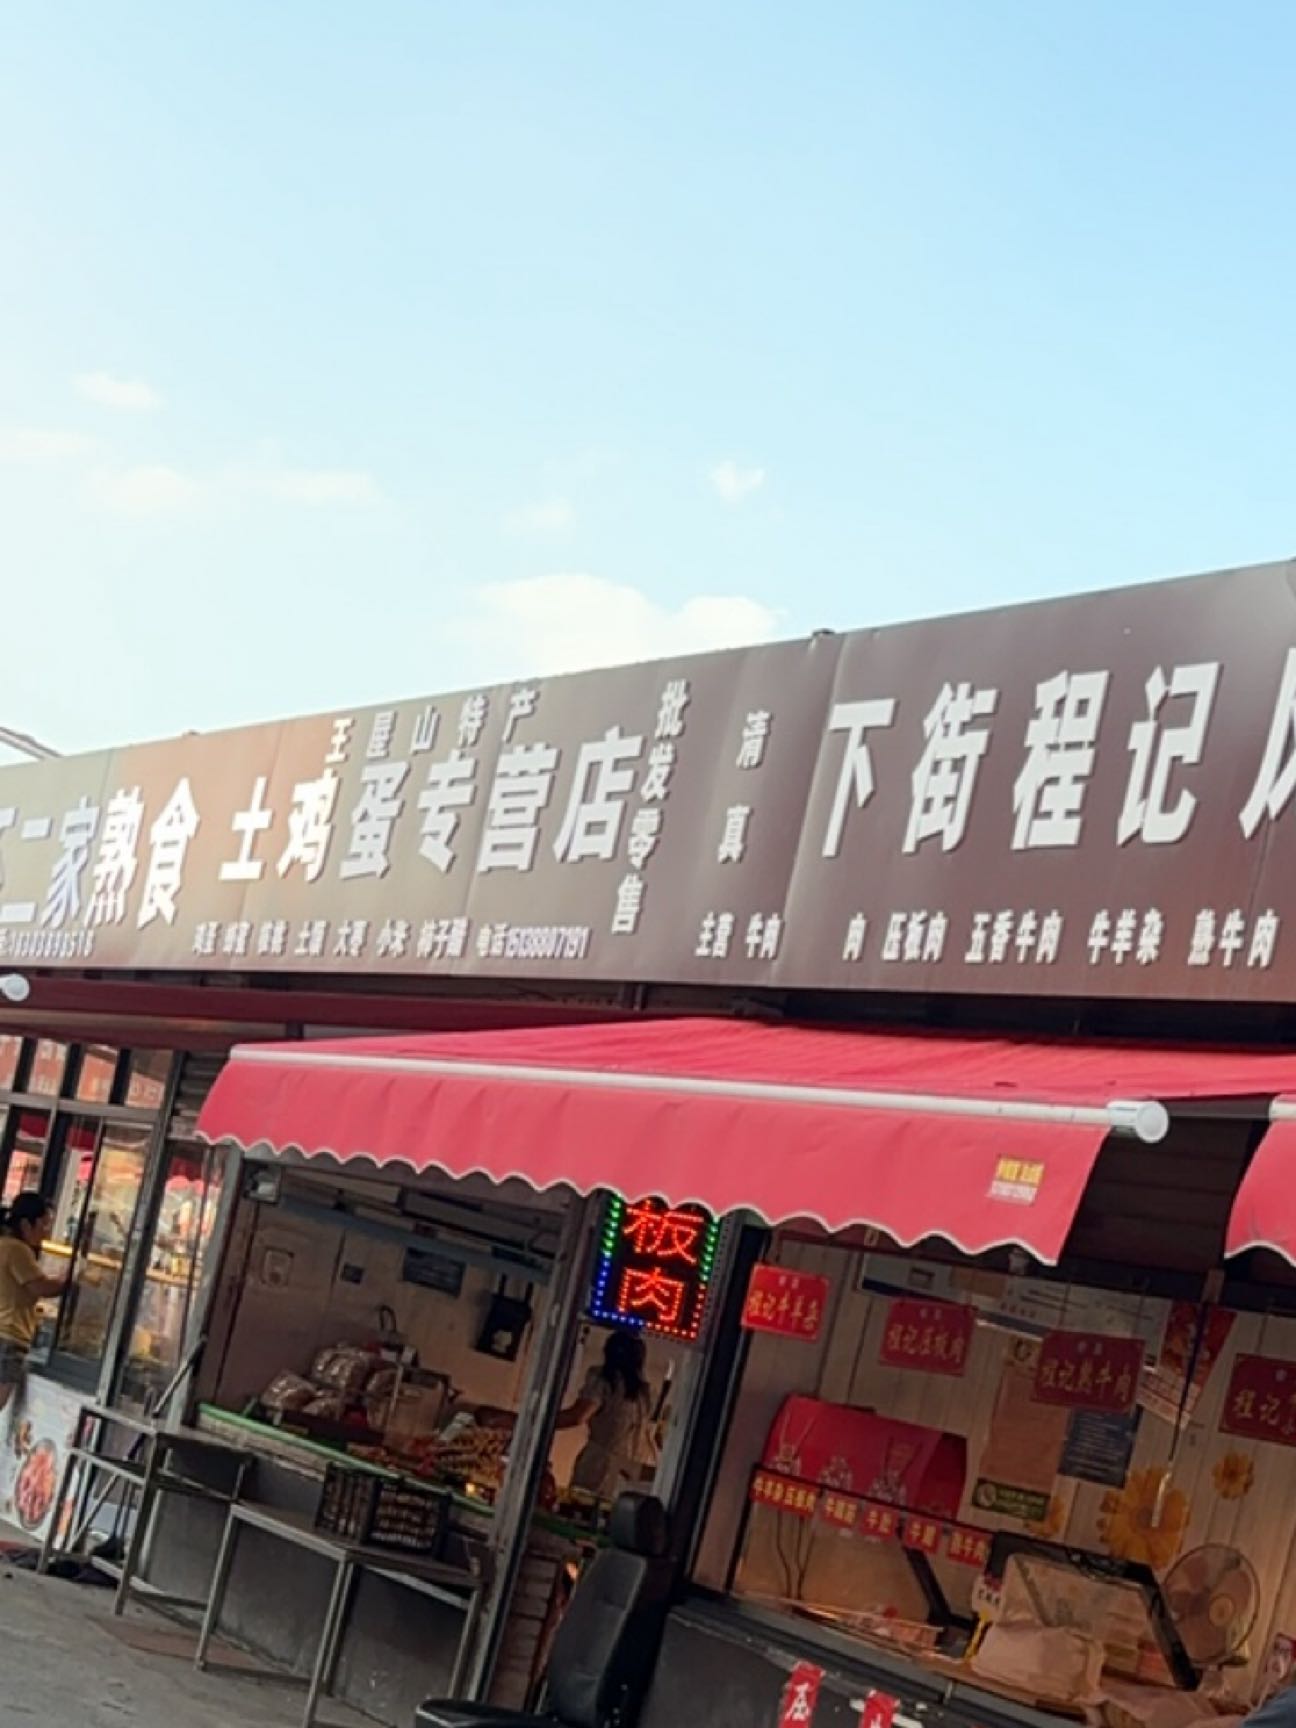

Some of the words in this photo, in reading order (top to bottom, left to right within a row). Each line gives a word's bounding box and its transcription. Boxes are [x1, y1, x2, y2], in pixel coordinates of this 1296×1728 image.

[218, 726, 643, 882] 土鸡蛋专营店
